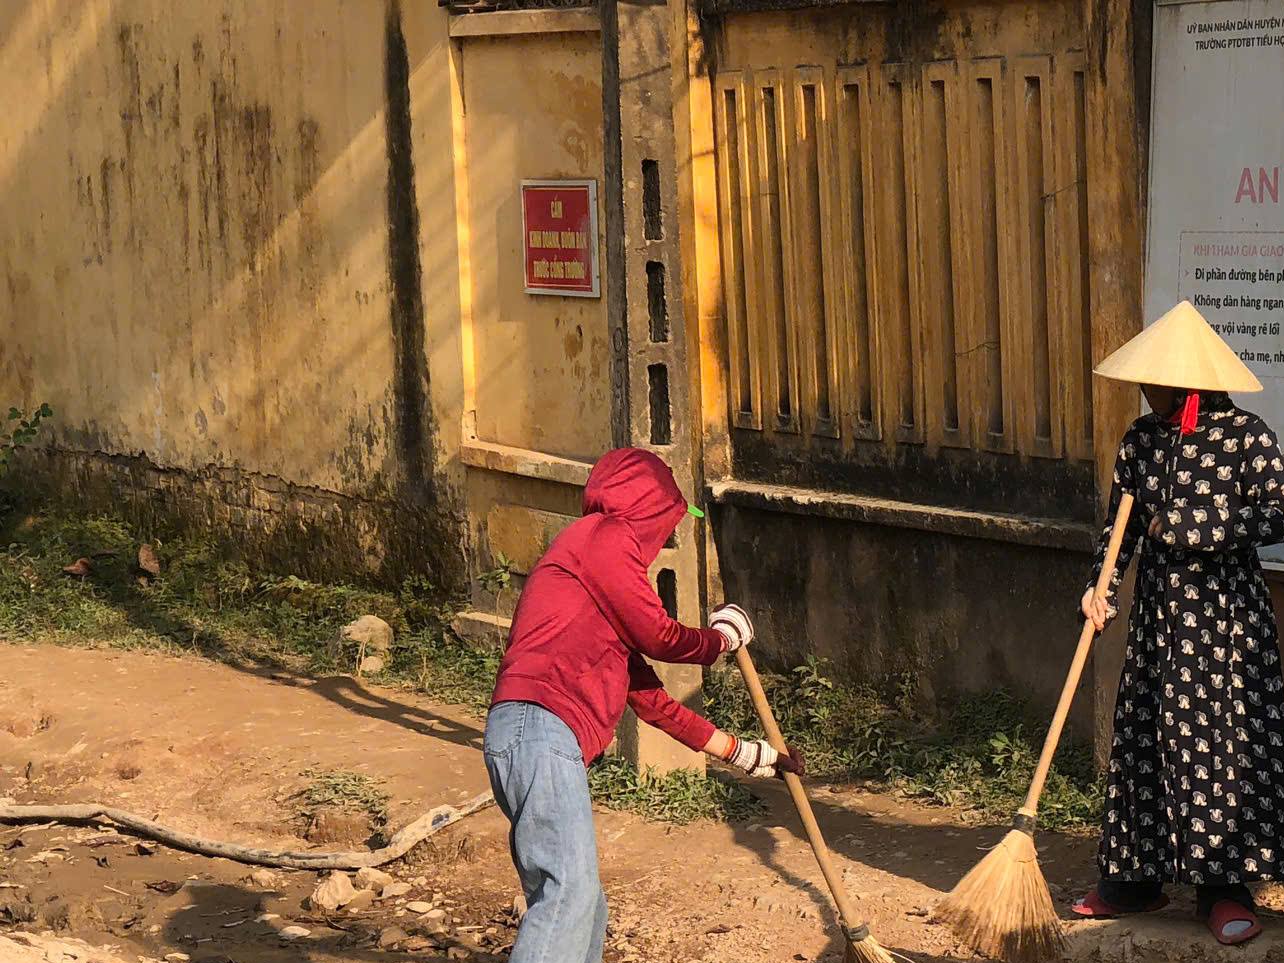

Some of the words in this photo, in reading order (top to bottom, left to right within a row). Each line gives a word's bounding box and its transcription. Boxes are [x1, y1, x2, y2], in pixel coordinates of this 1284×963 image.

[1198, 23, 1213, 33] BAN
[1214, 19, 1236, 32] NHÂN
[1235, 166, 1279, 203] AN
[1195, 267, 1205, 280] Đi
[1206, 266, 1227, 283] phần
[1228, 268, 1257, 284] đường
[1259, 268, 1275, 281] bên
[1194, 294, 1221, 309] Không
[1240, 295, 1261, 310] hàng
[1222, 321, 1235, 336] vội
[1236, 322, 1257, 337] vàng
[1240, 348, 1255, 361] cha
[1257, 352, 1272, 365] mẹ,
